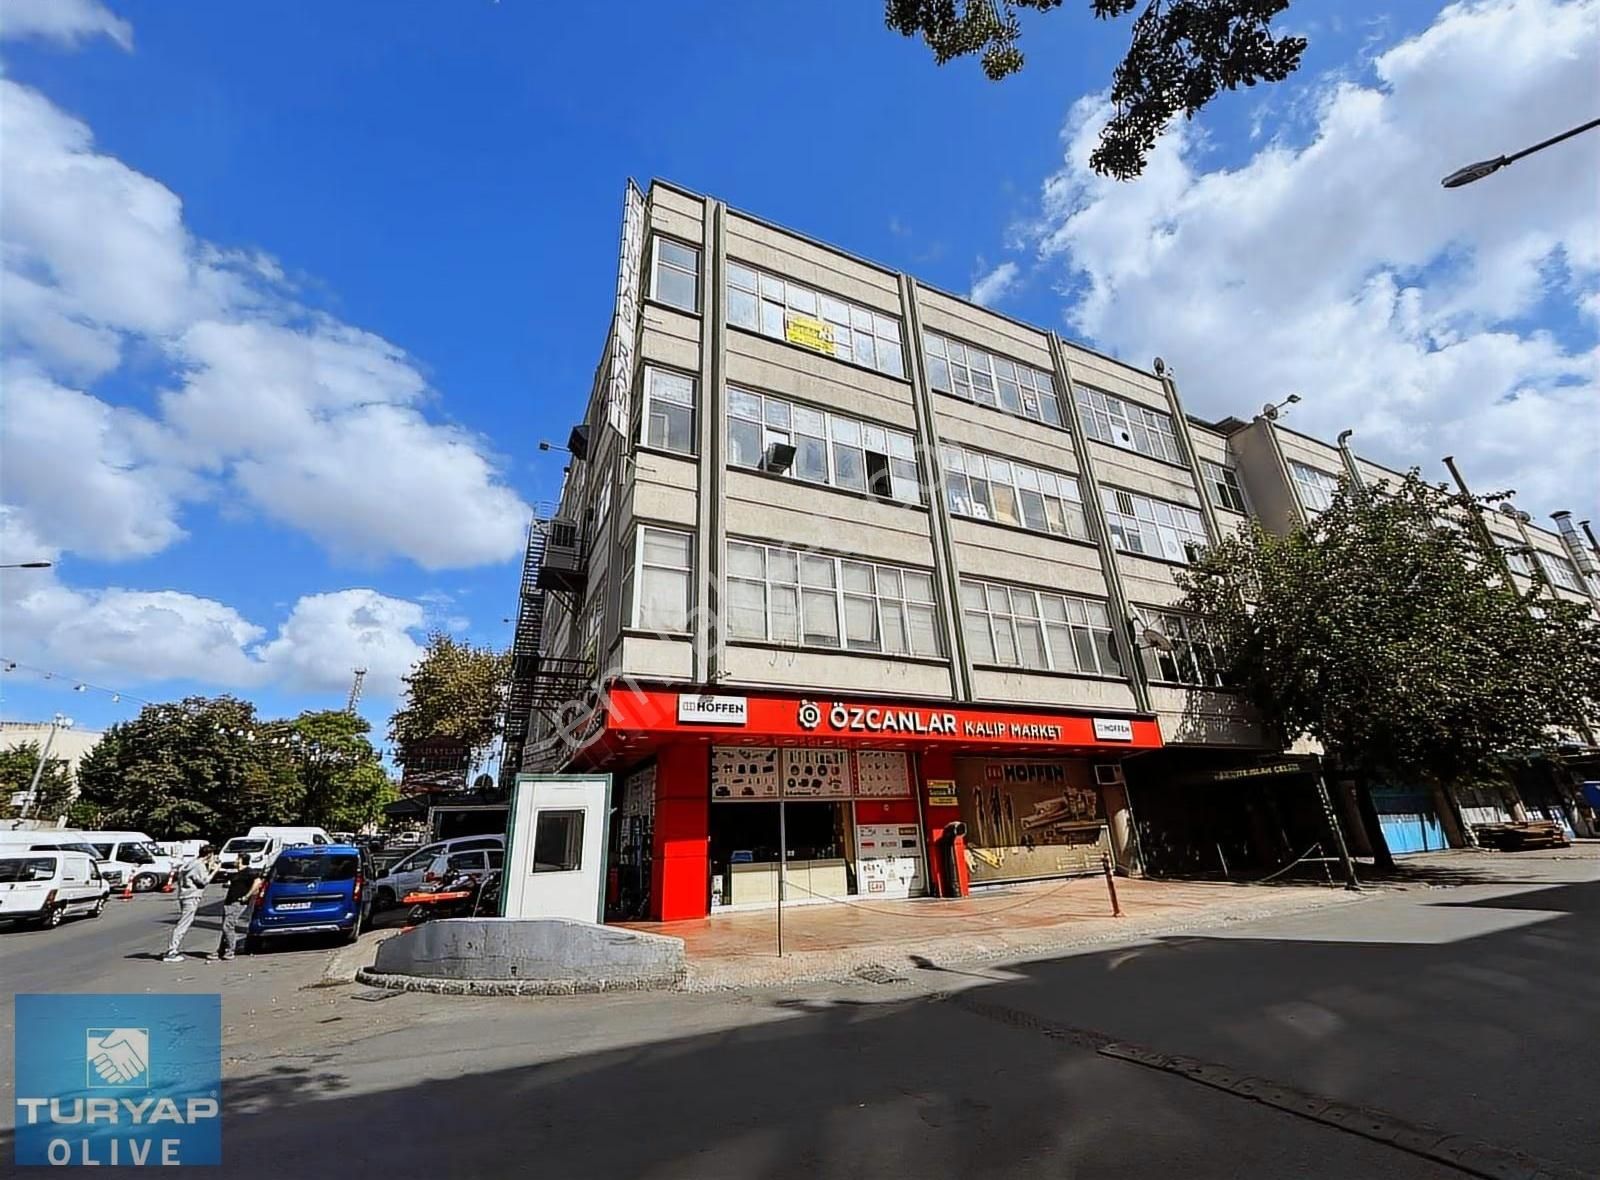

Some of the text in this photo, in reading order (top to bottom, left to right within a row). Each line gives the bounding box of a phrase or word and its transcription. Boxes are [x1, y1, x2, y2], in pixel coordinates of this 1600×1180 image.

[697, 702, 744, 713] HOFFEN
[830, 702, 1063, 740] ÖZCANLAR KALIP MARKET
